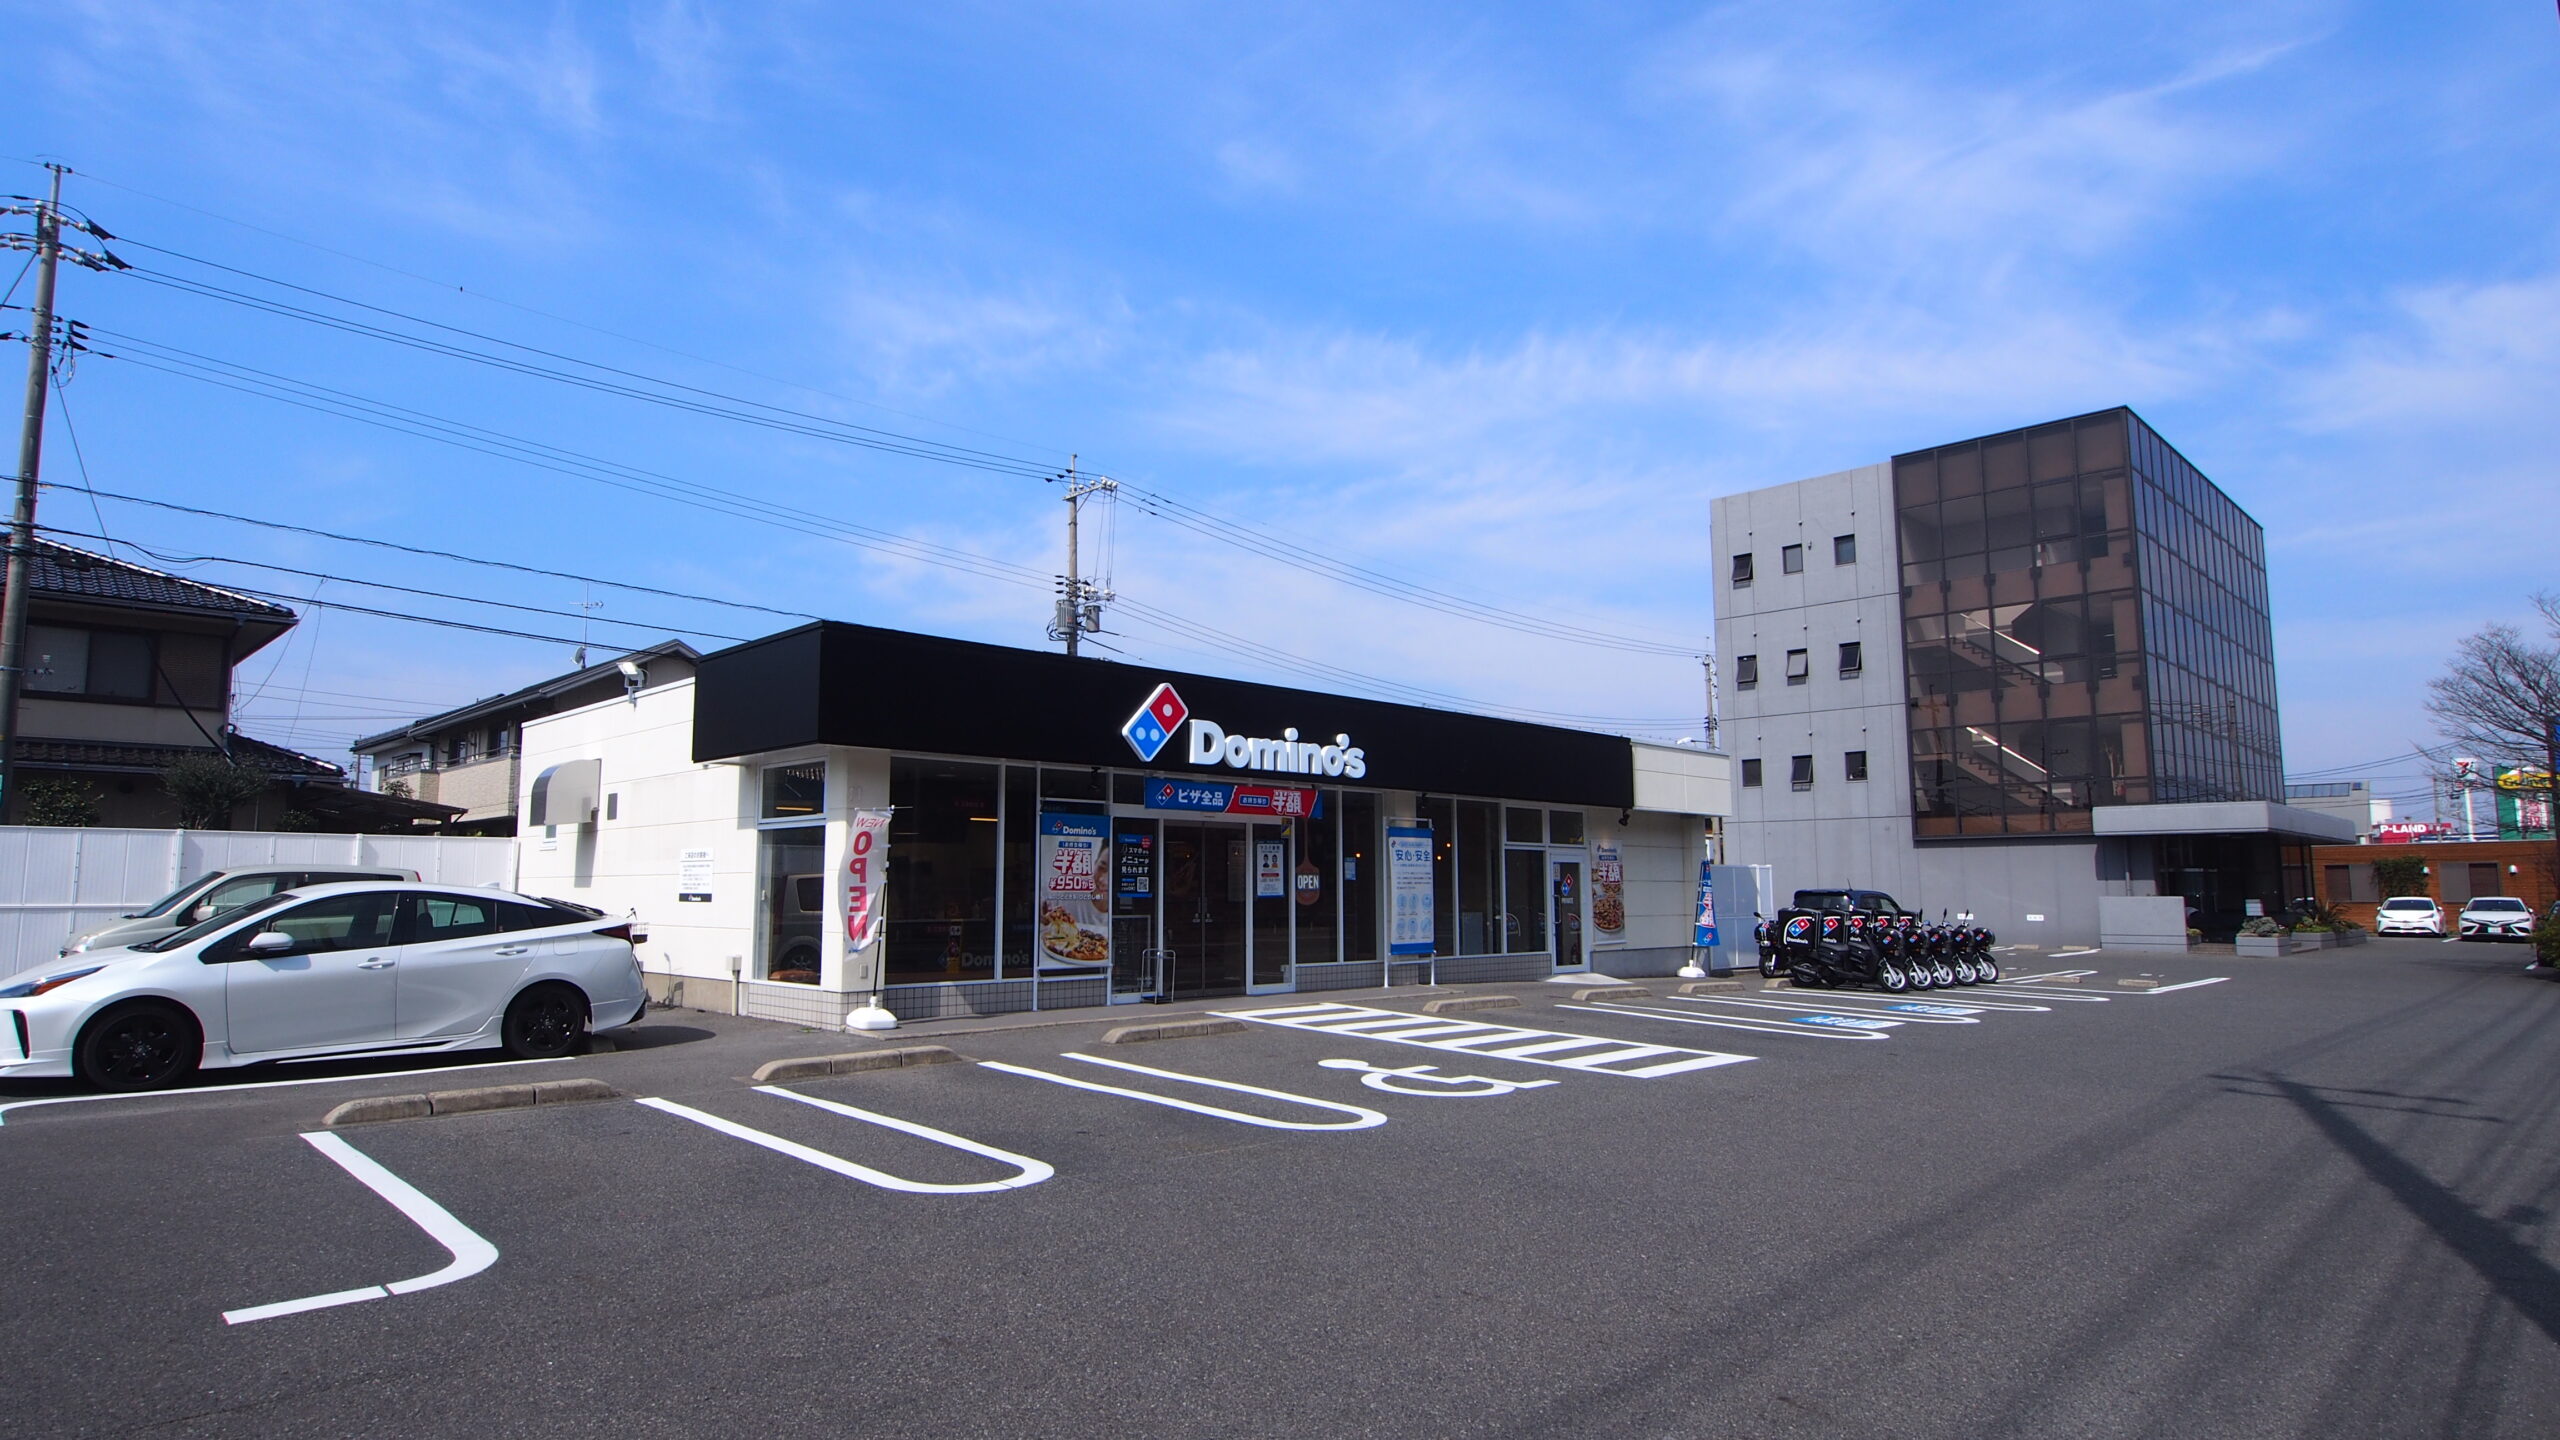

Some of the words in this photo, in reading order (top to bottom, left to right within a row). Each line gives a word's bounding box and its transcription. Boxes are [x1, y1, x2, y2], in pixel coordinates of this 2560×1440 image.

[1189, 719, 1367, 779] Domino's
[1178, 788, 1224, 807] ピザ全品
[1272, 789, 1303, 814] 半額
[1062, 825, 1097, 836] Domino's
[2380, 824, 2427, 834] P-LAND
[1052, 848, 1093, 876] 半額
[1297, 874, 1320, 890] OPEN
[961, 949, 1030, 968] Domno's
